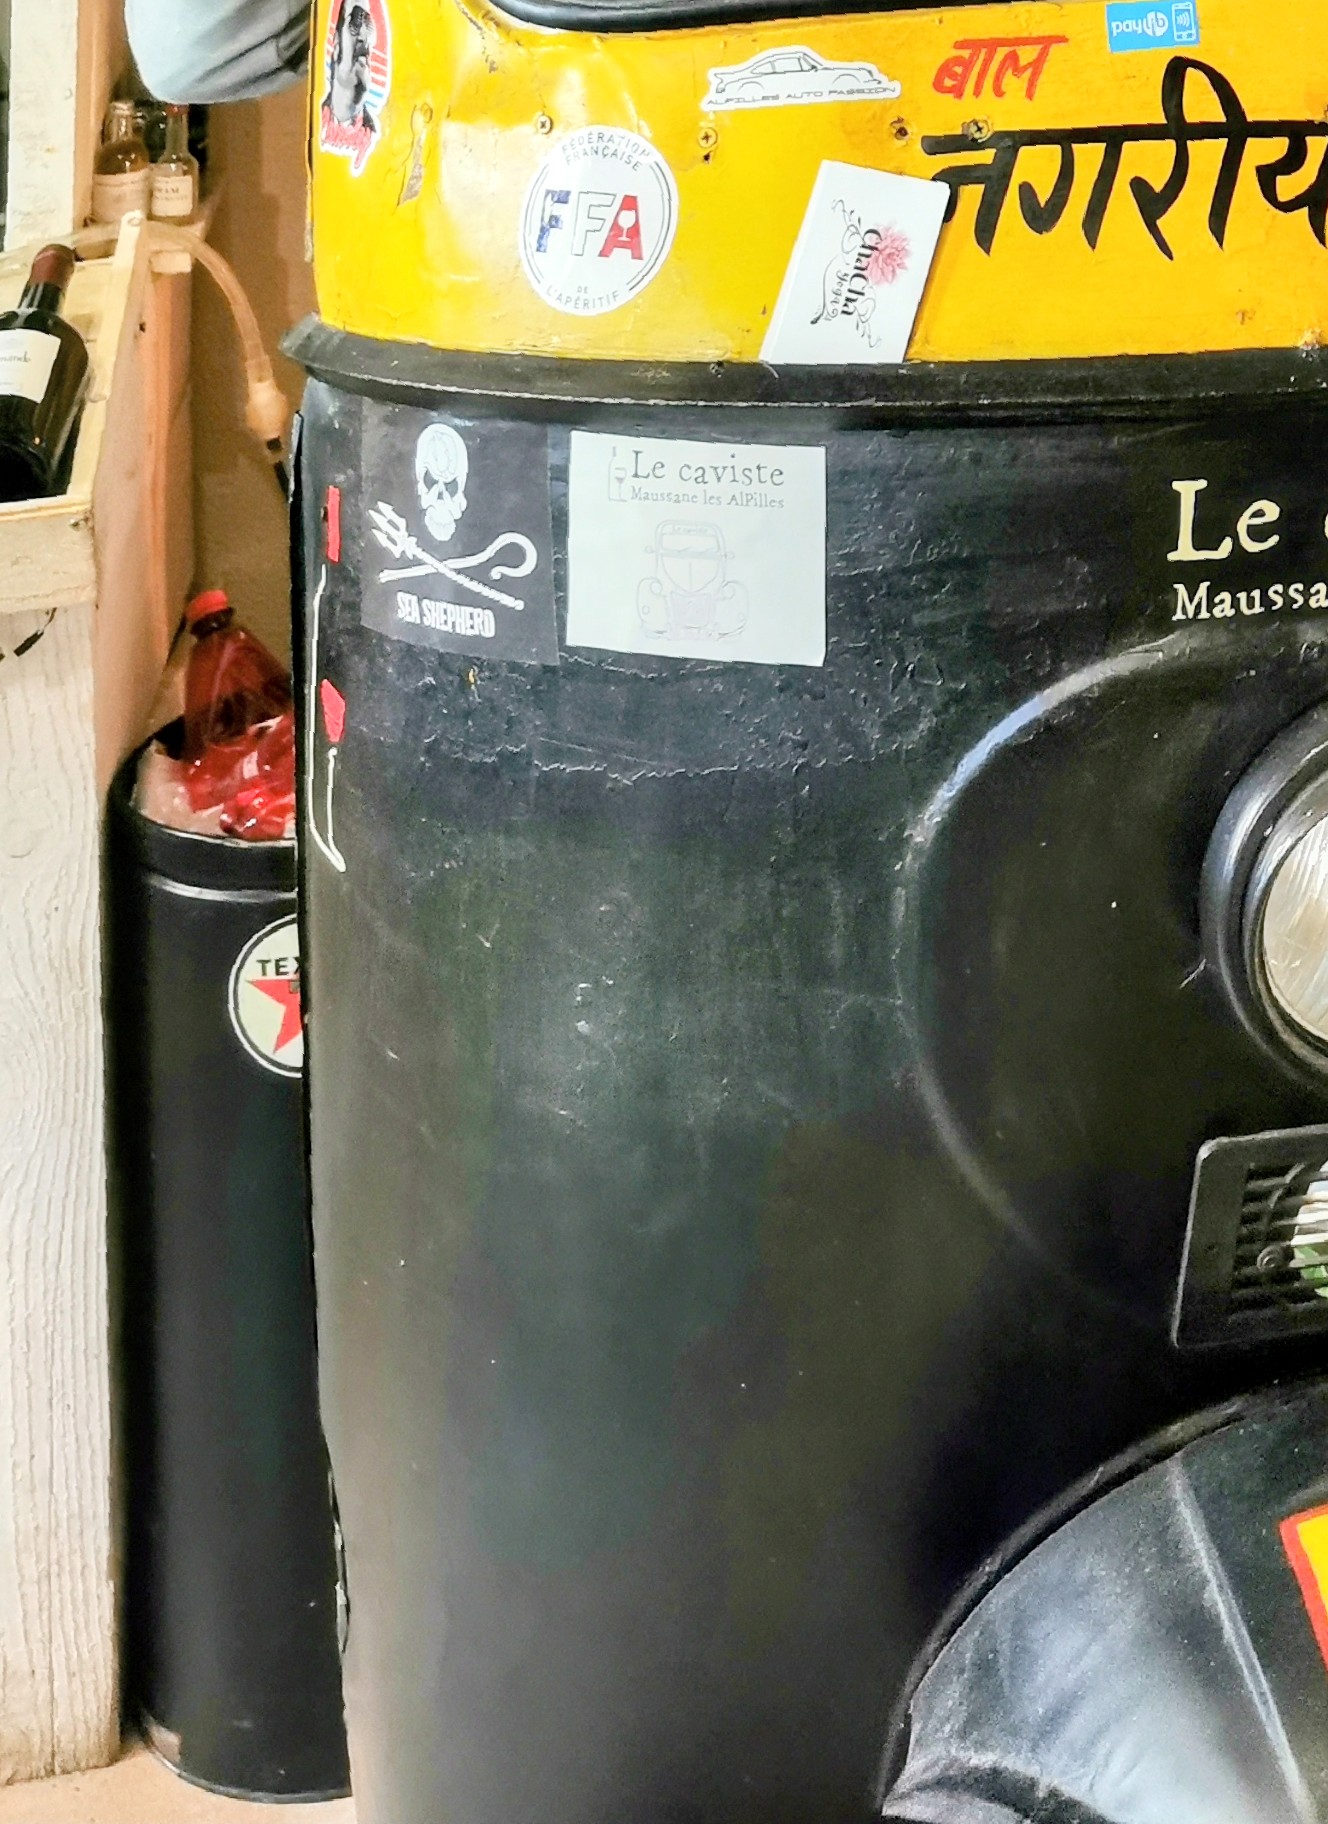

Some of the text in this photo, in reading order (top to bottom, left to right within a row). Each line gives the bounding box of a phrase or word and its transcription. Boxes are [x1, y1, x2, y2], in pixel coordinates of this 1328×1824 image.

[932, 34, 1069, 102] बाल
[786, 89, 823, 100] AUTO
[828, 86, 896, 97] PASSION
[561, 132, 651, 159] FÉDÉRATION
[565, 143, 643, 173] FRANÇAISE
[535, 188, 644, 261] FFA
[840, 228, 883, 316] ChaCha
[546, 283, 621, 310] L'APÉRITIF
[577, 285, 589, 295] DE
[631, 449, 785, 487] Le caviste
[631, 485, 785, 509] Maussane les AlPilles
[1166, 477, 1281, 563] Le
[396, 590, 497, 639] SEA SHEPHERD
[256, 956, 300, 977] TEX
